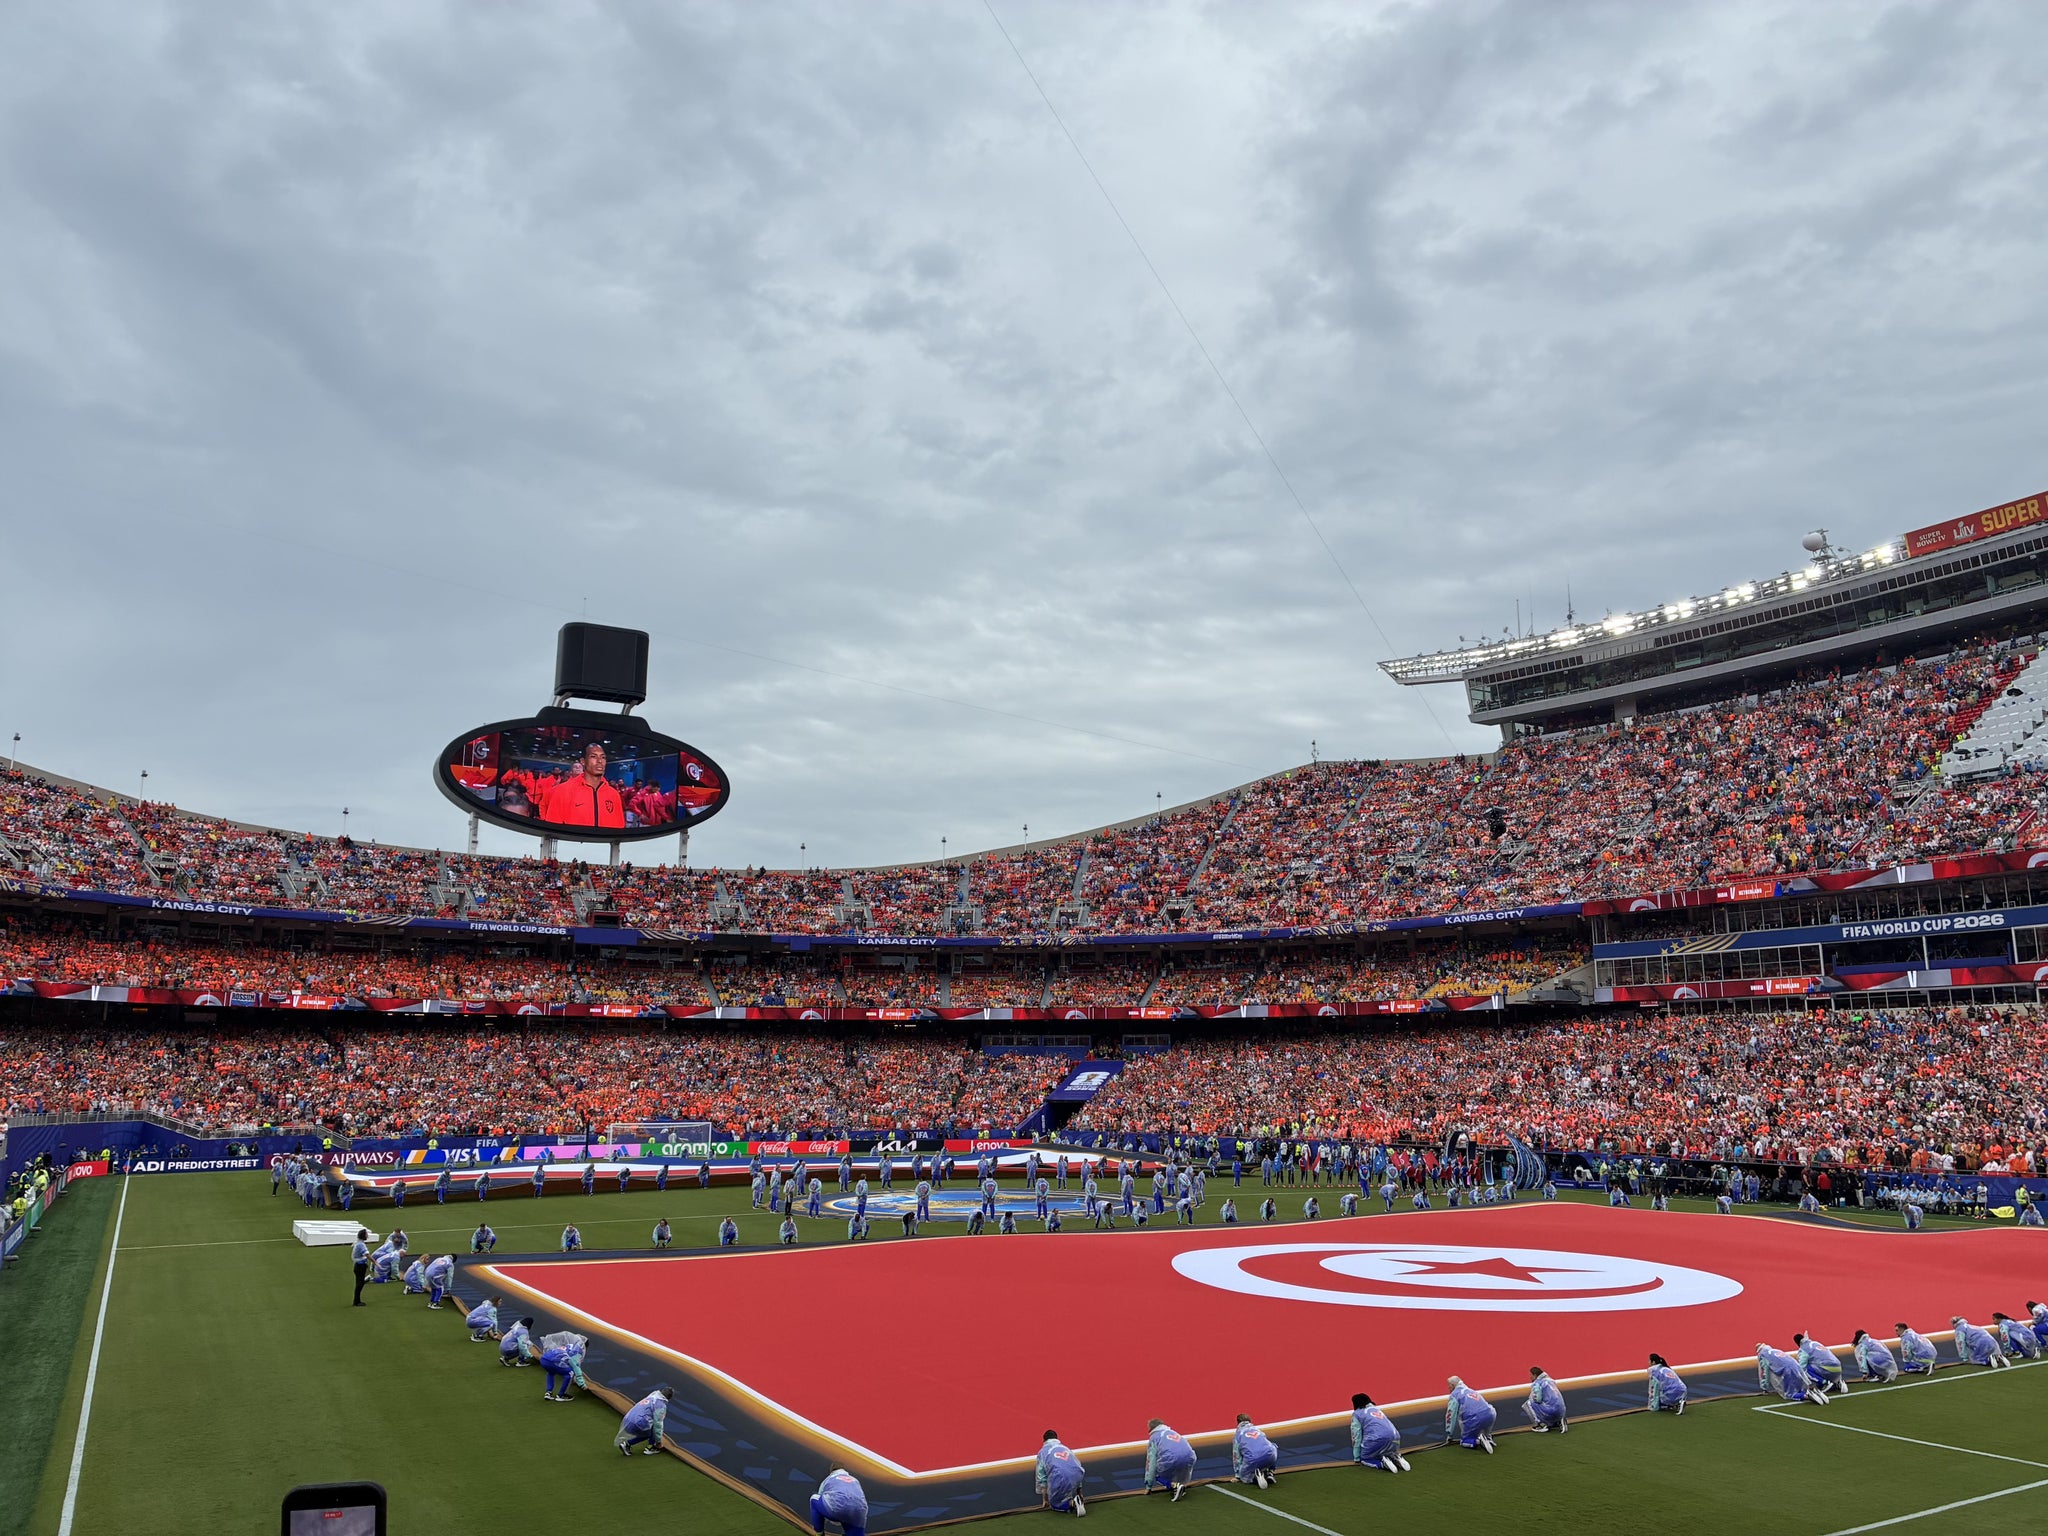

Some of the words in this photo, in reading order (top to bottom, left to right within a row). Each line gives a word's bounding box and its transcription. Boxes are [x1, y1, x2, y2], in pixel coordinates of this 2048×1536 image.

[1981, 499, 2042, 532] SUPER
[1919, 530, 1941, 541] SUPER
[1916, 537, 1938, 548] BOWL
[152, 900, 215, 912] KANSAS
[218, 905, 253, 916] CITY
[1445, 912, 1494, 924] KANSAS
[1495, 909, 1524, 920] CITY
[469, 922, 488, 931] FIFA
[489, 924, 519, 932] WORLD
[520, 925, 537, 933] CUP
[538, 926, 567, 935] 2026
[1842, 925, 1871, 938] FIFA
[1871, 921, 1921, 936] WORLD
[1923, 918, 1951, 931] CUP
[1953, 913, 2005, 929] 2026
[476, 1138, 499, 1148] FIFA
[441, 1148, 480, 1162] VISA
[132, 1161, 165, 1172] ADI
[167, 1159, 260, 1170] PREDICTSTREET
